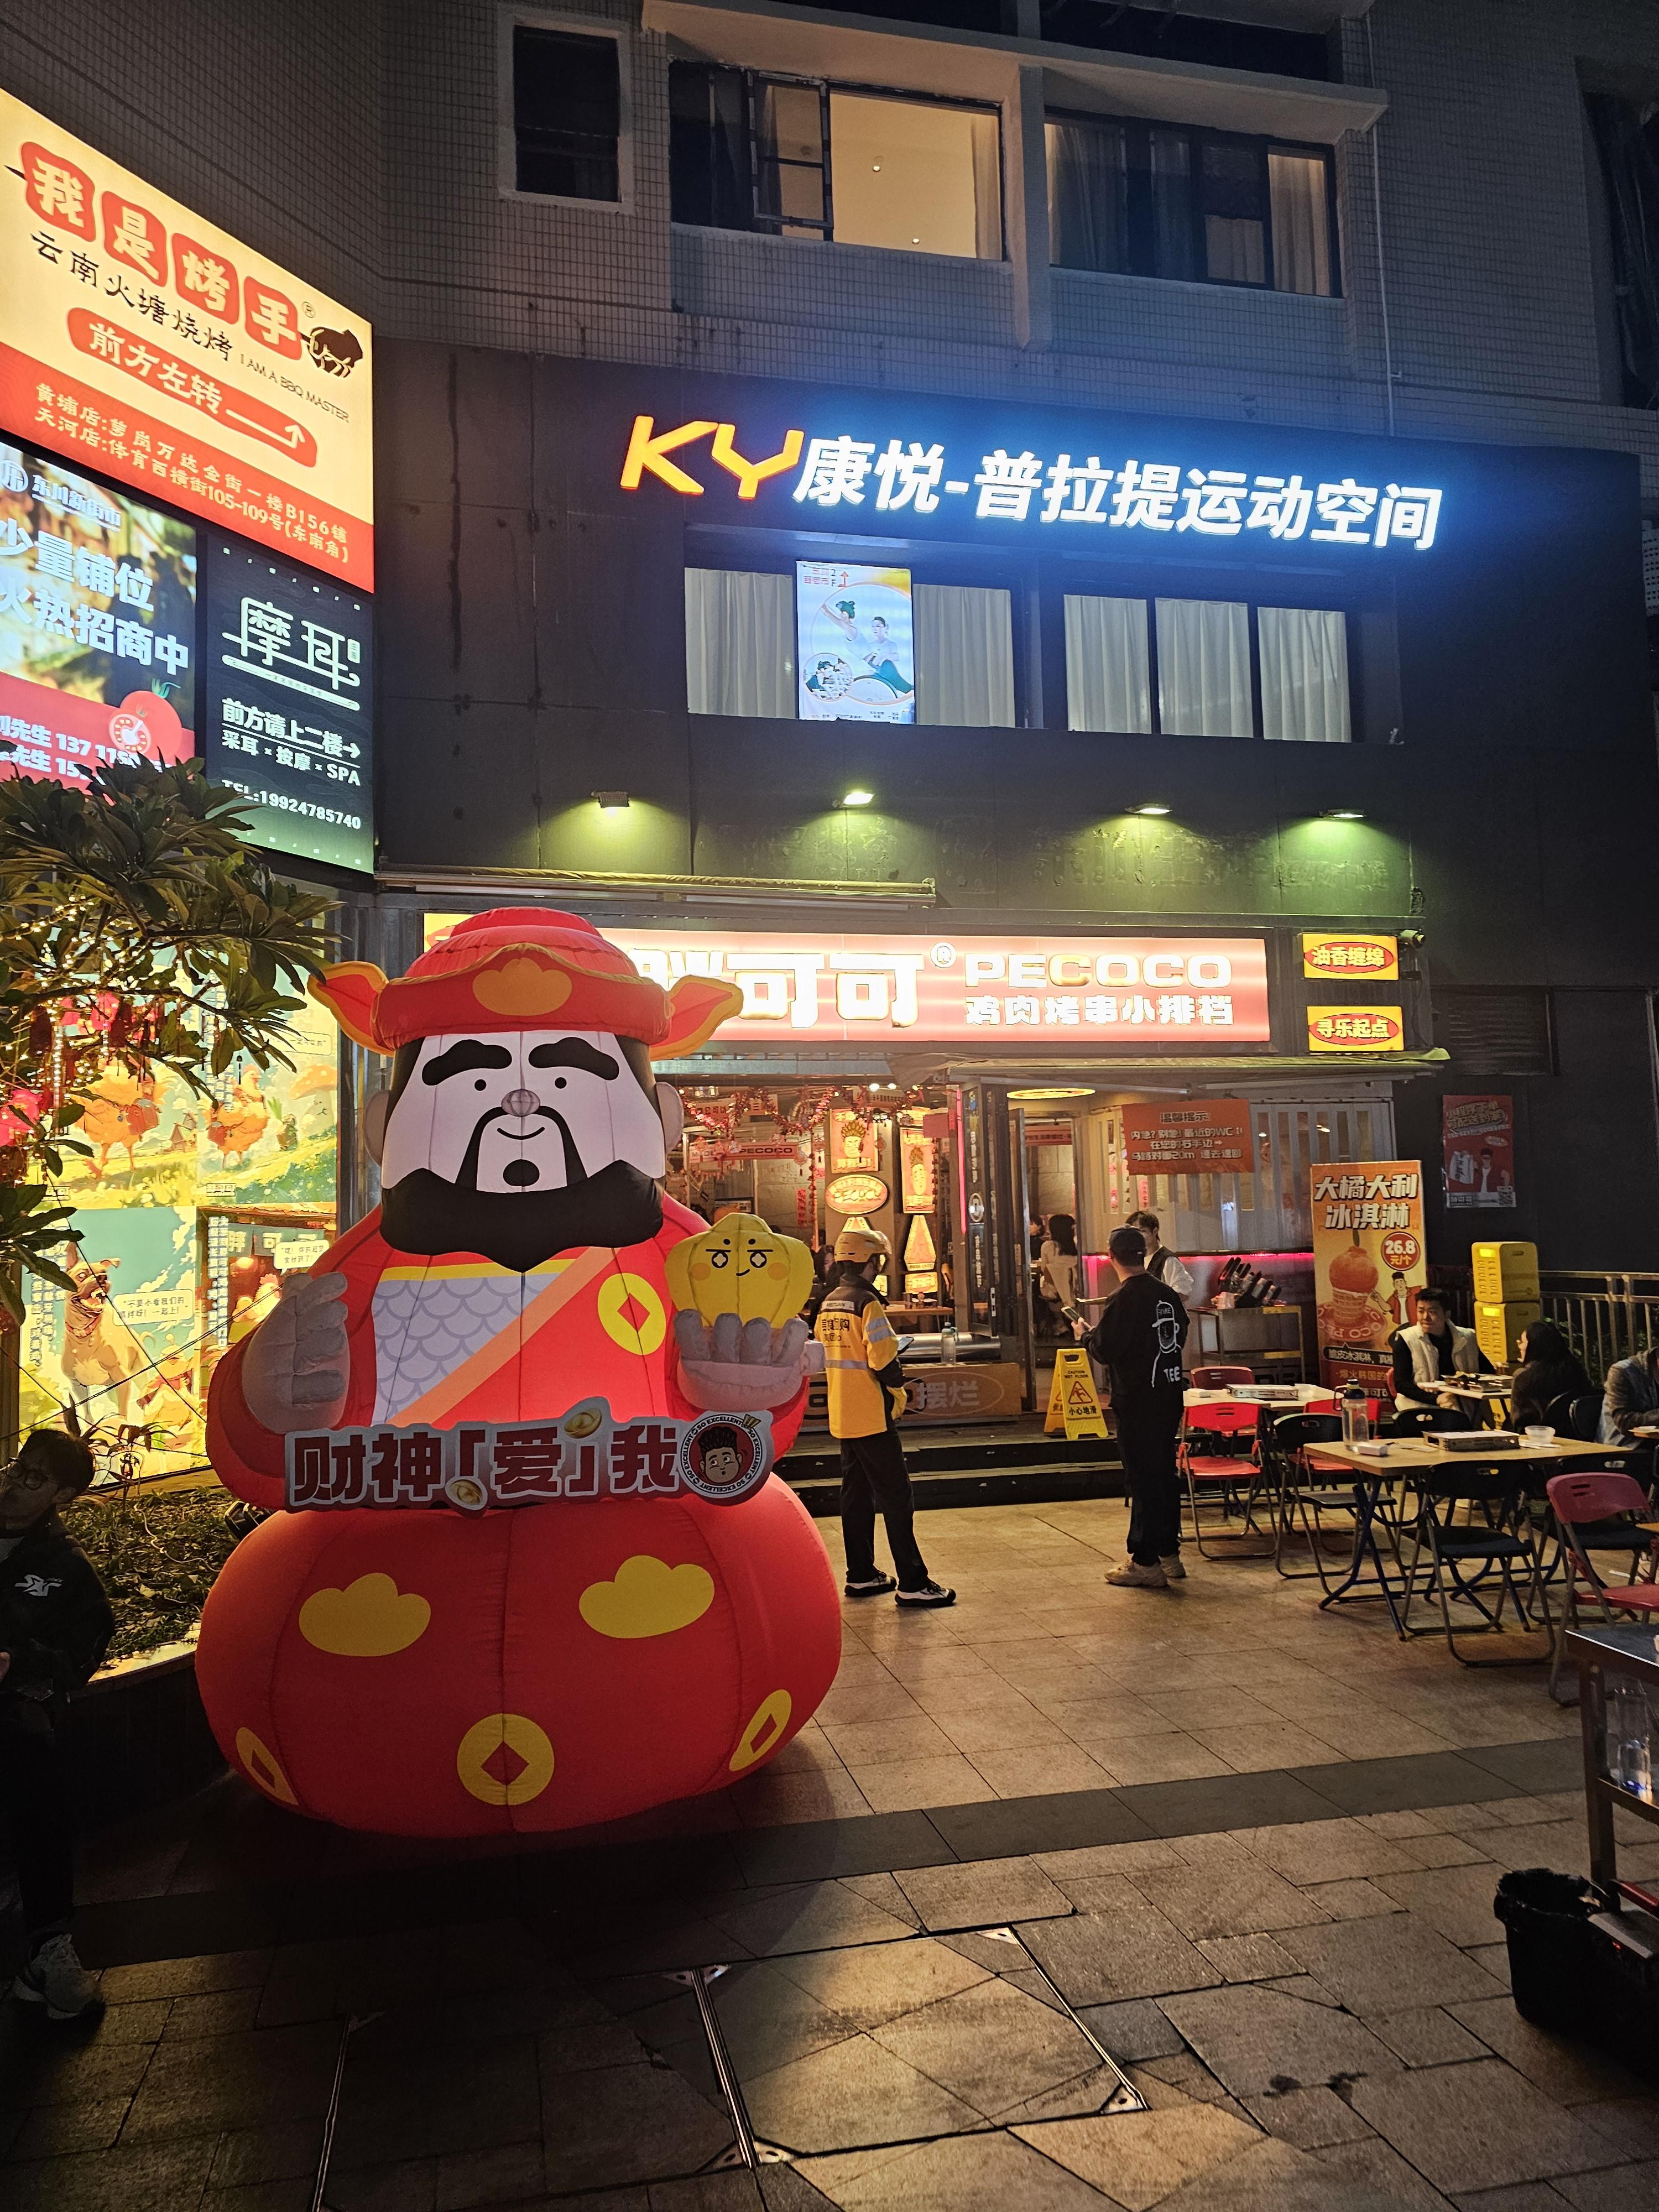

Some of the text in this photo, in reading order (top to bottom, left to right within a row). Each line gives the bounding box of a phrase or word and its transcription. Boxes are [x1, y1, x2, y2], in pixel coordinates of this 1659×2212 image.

[35, 156, 297, 347] 我是烤手
[30, 230, 233, 361] 云南火塘烧烤
[88, 322, 223, 415] 前方左转
[247, 358, 267, 377] AM
[269, 371, 278, 384] A
[280, 375, 304, 398] BBQ
[305, 390, 350, 424] MASTER
[619, 415, 805, 499] KY
[791, 435, 1443, 550] 康悦-普拉提运动空间
[0, 518, 154, 612] 少量铺位
[0, 576, 189, 676] 火热招商中
[55, 733, 91, 756] 137
[222, 698, 343, 758] 前方请上二楼
[222, 730, 361, 786] 采耳 按摩 SPA
[964, 953, 1232, 988] PECOCO
[964, 994, 1234, 1025] 鸡肉烤串小排档
[1316, 1018, 1392, 1039] 寻乐起点
[1314, 1173, 1419, 1201] 大橘大利
[1325, 1202, 1410, 1229] 冰淇淋
[1385, 1240, 1416, 1254] 26.8
[1389, 1255, 1412, 1265] 元/个
[1163, 1366, 1181, 1383] TEE
[706, 1416, 743, 1427] EXCELLENT
[1068, 1405, 1097, 1416] 小心地滑
[682, 1434, 694, 1470] EXCELLENT
[749, 1438, 761, 1474] EXCELLENT
[700, 1482, 737, 1493] EXCELLENT
